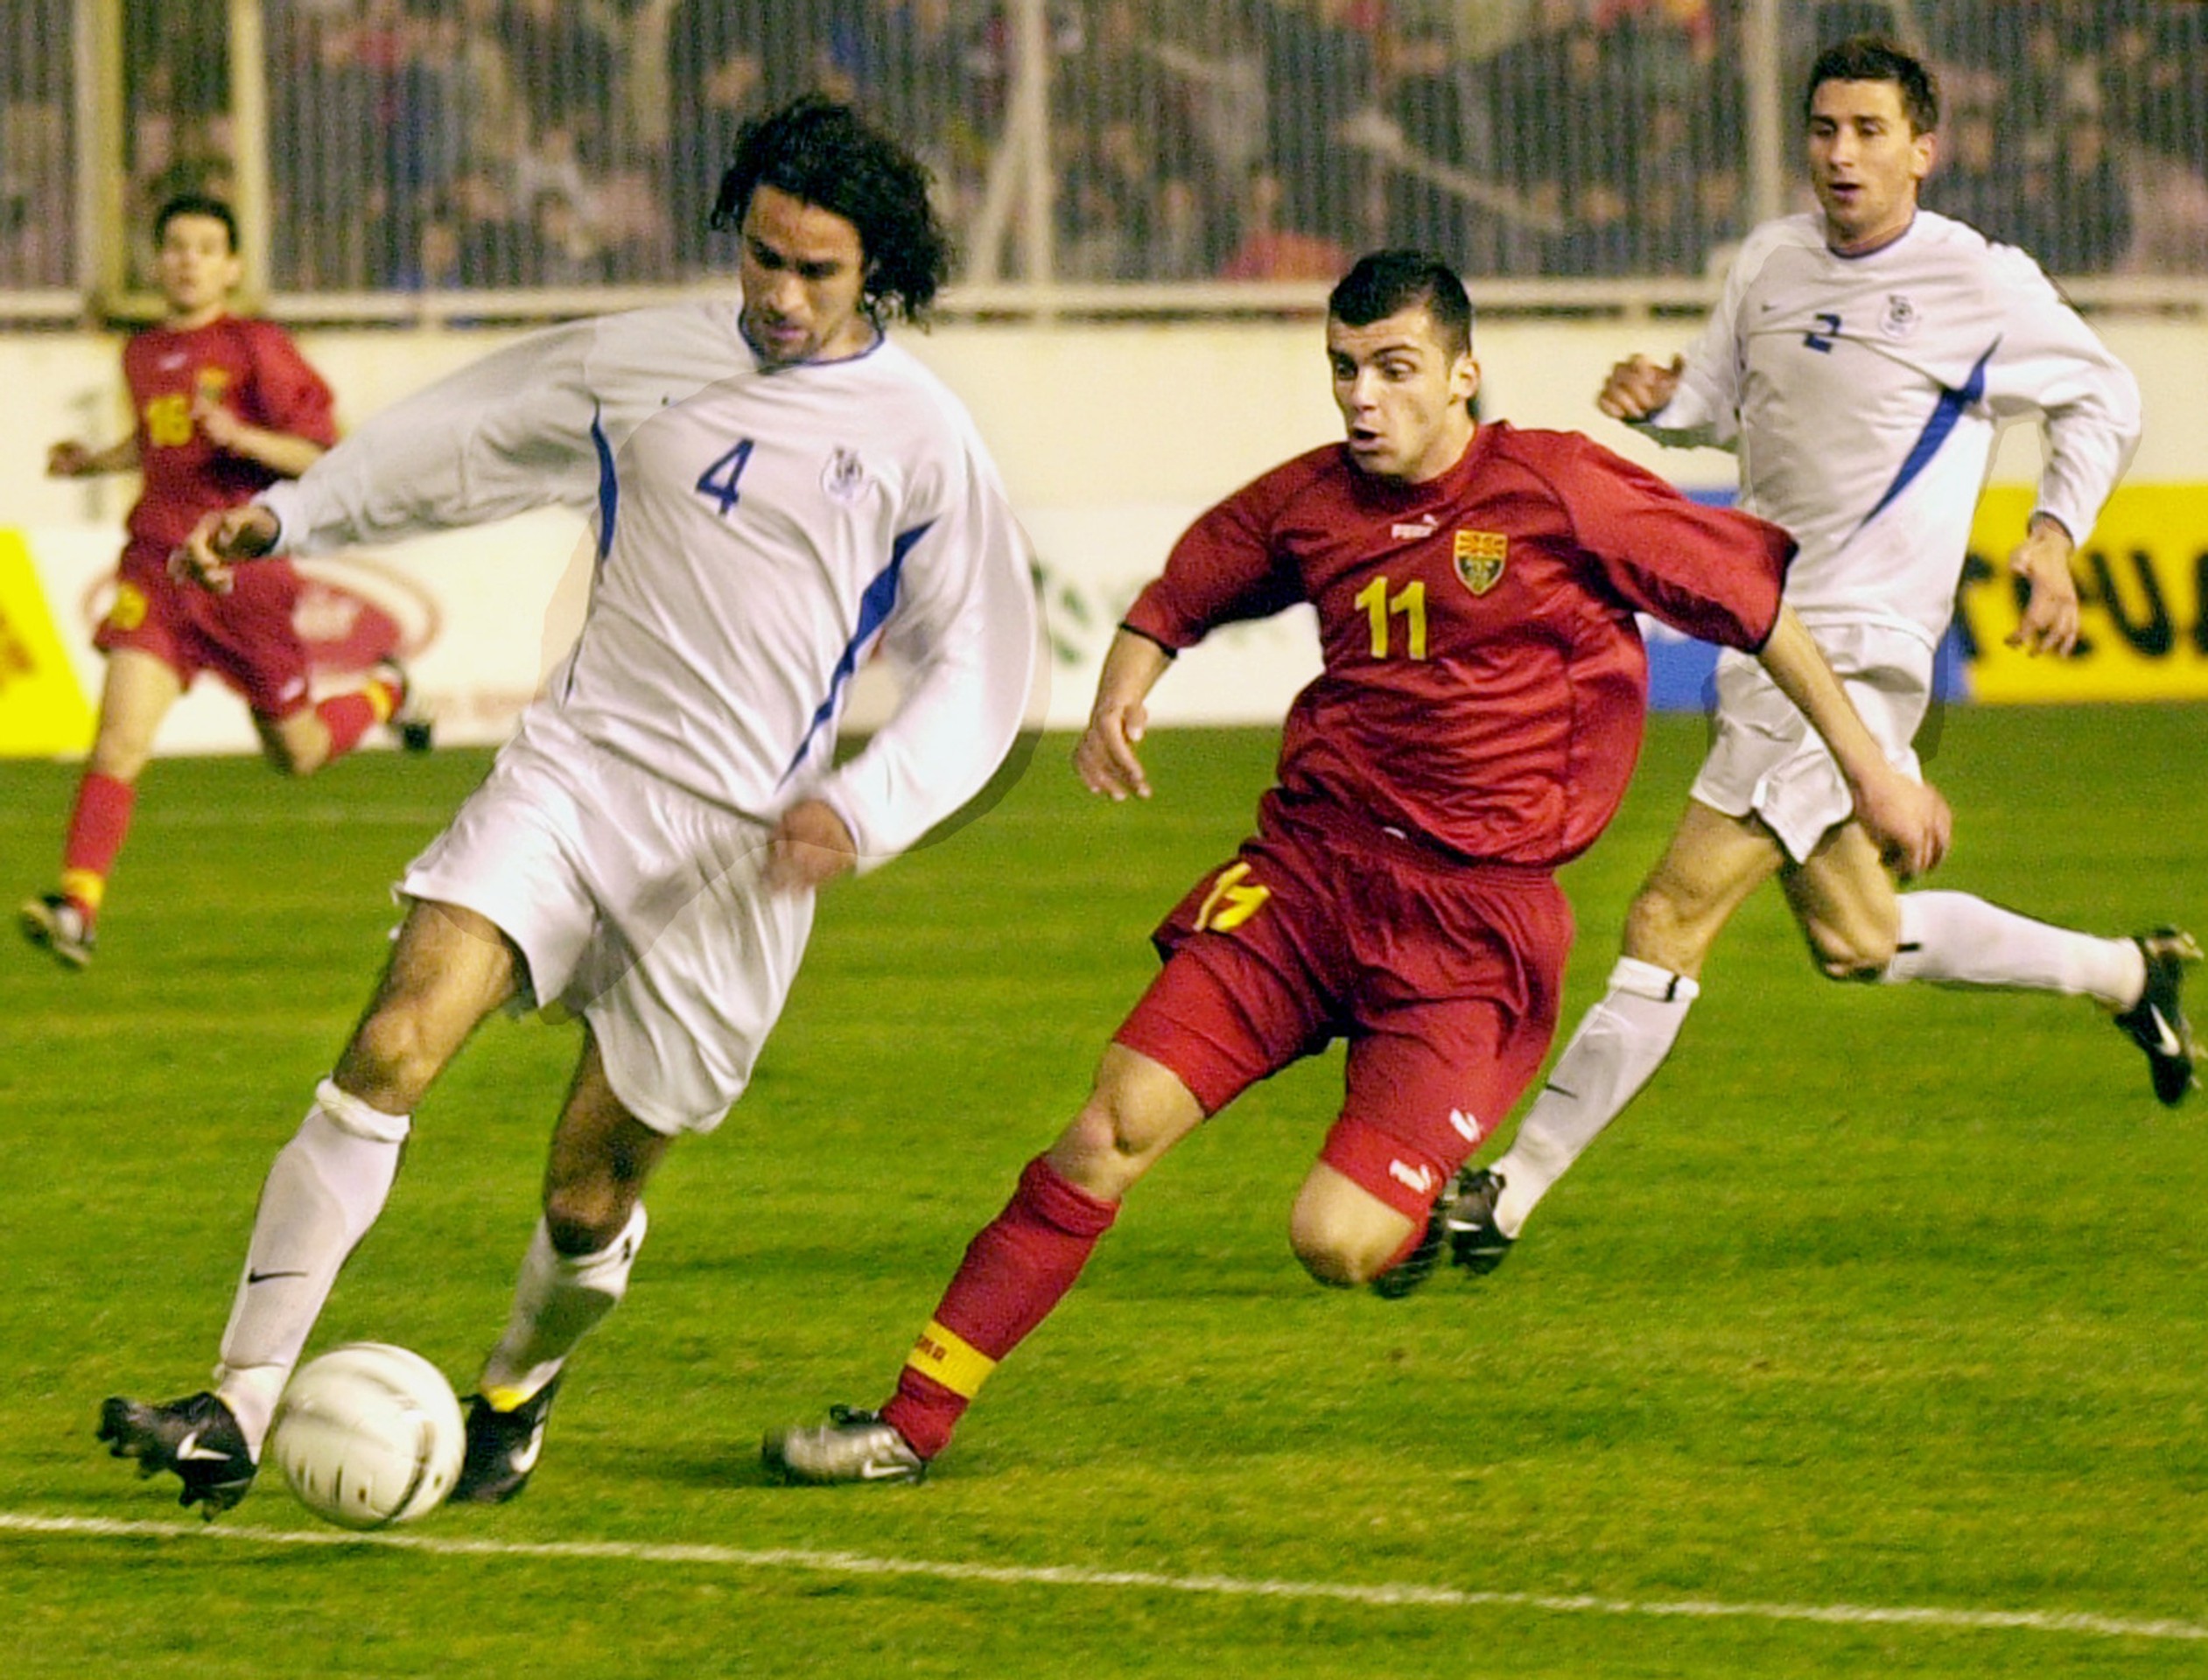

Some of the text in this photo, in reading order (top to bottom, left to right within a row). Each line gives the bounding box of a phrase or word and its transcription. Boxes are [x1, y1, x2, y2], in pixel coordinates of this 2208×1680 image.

[1803, 312, 1841, 354] 2
[696, 438, 754, 516] 4
[1356, 576, 1427, 661] 11
